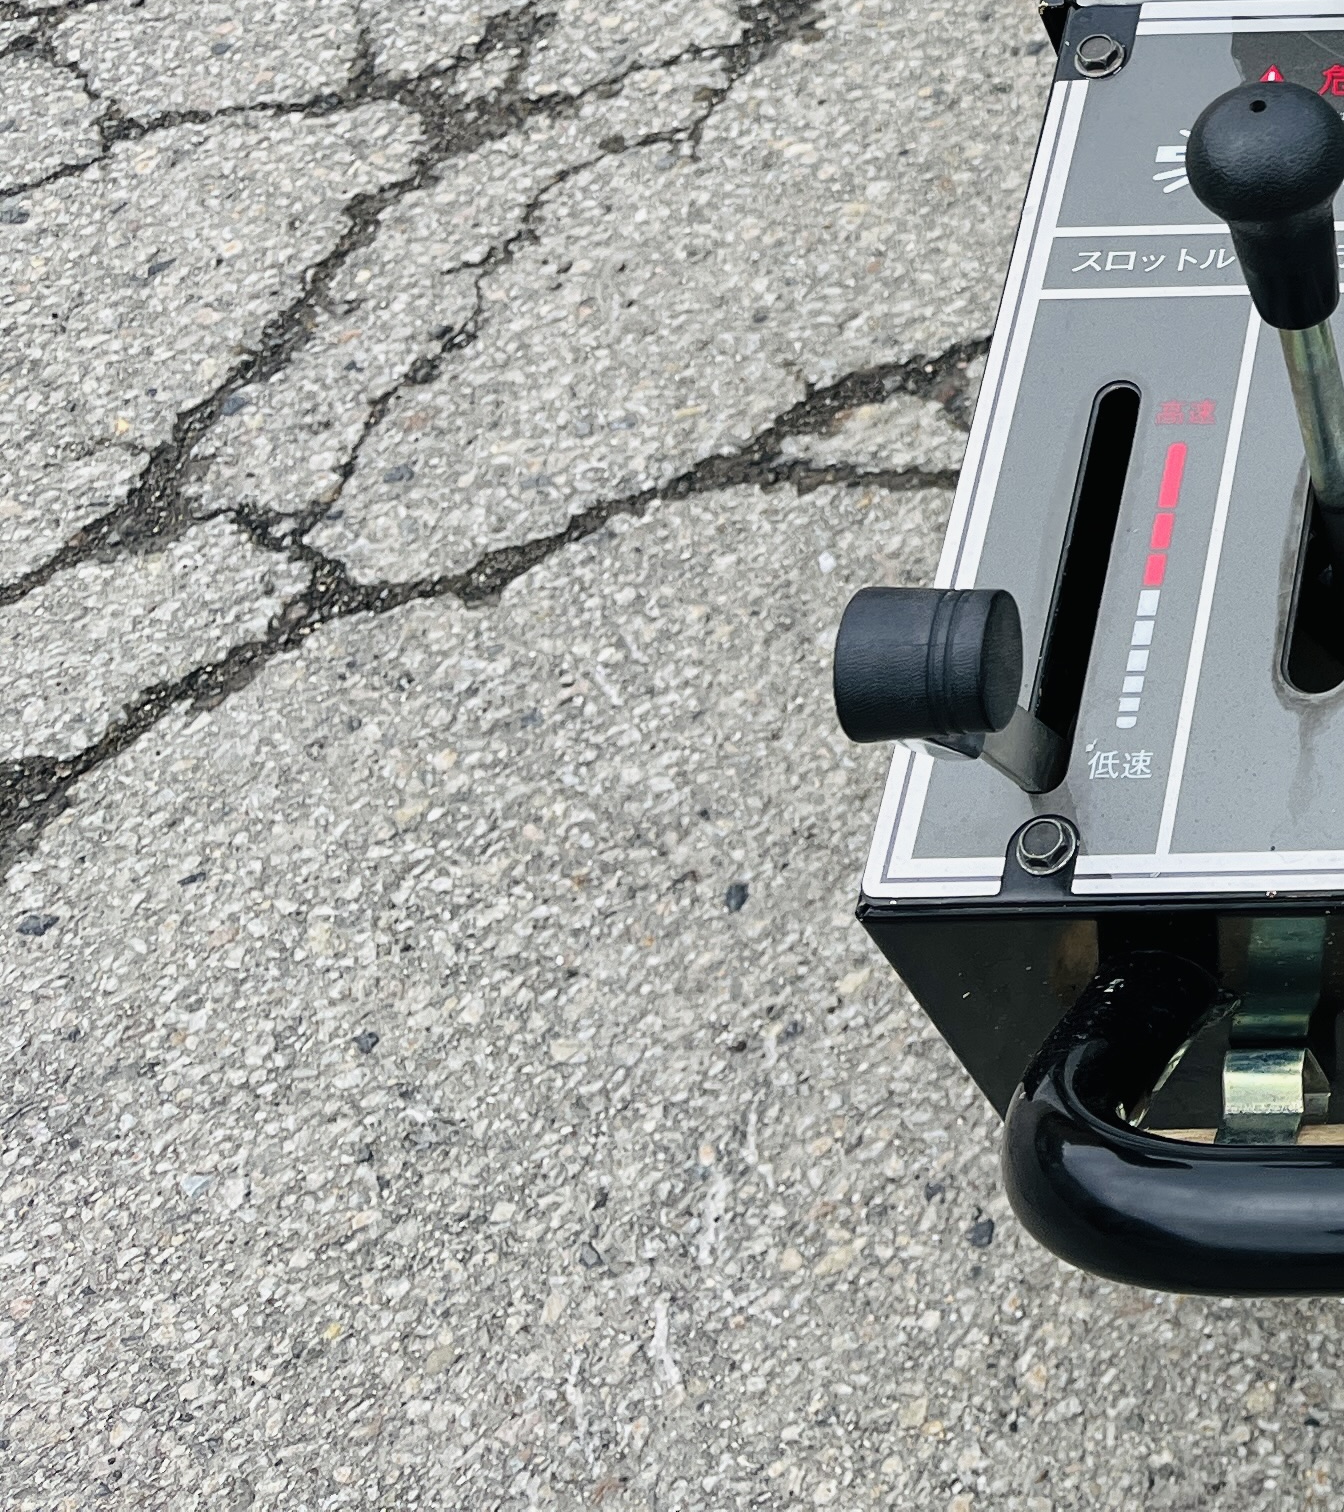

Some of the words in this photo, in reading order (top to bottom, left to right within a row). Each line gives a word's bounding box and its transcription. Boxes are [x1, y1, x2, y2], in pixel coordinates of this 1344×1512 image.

[1071, 246, 1236, 273] スロットル
[1155, 398, 1217, 425] 高速
[1087, 750, 1154, 781] 低速
